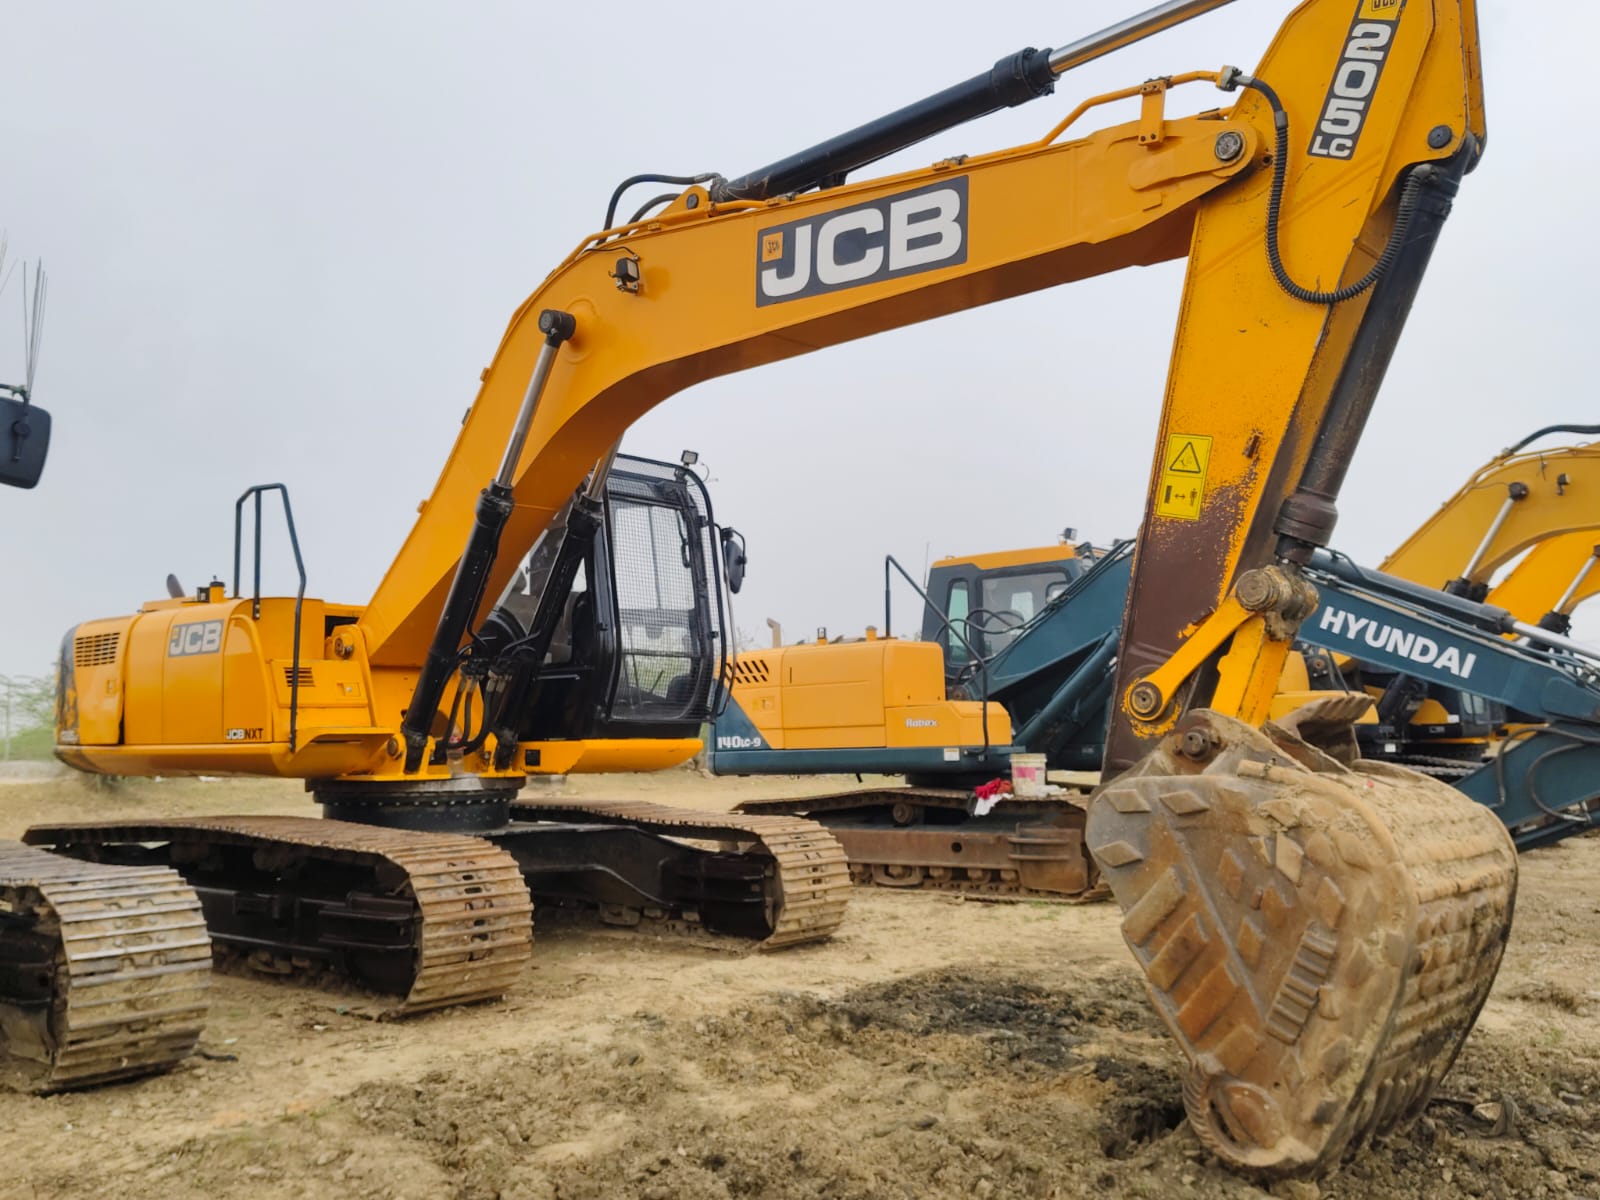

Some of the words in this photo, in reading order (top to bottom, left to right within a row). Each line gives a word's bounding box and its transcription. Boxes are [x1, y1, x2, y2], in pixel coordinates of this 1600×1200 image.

[1320, 22, 1392, 136] 205
[1311, 135, 1353, 158] LC
[761, 188, 962, 297] JCB
[170, 622, 222, 655] JCB
[1319, 605, 1477, 679] HYUNDAI
